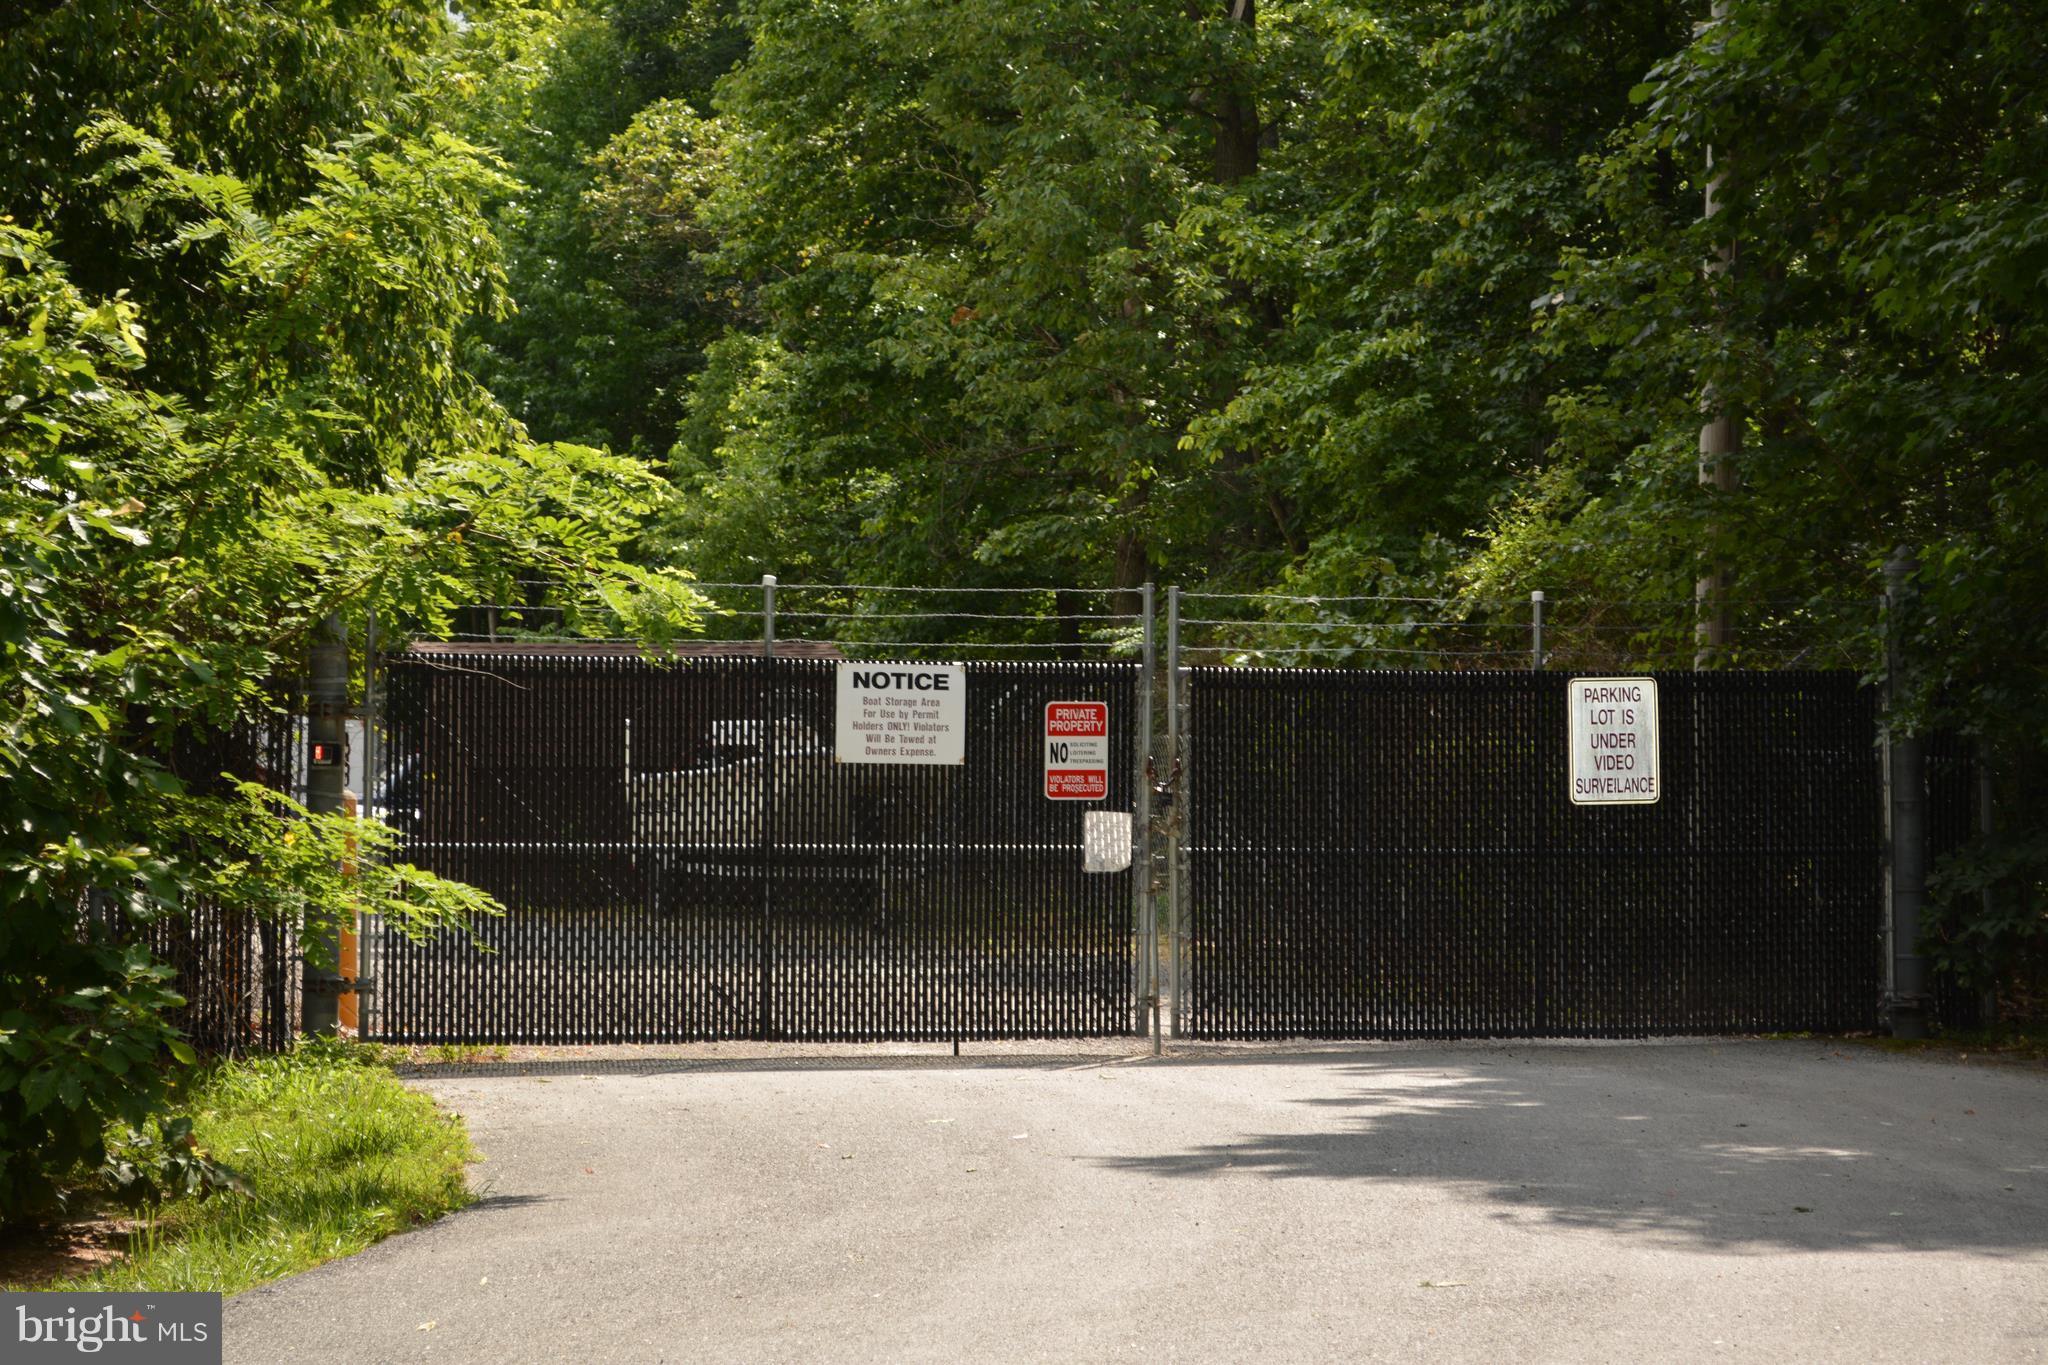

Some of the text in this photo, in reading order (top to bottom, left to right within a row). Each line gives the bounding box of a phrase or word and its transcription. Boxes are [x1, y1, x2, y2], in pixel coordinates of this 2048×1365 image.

[853, 671, 950, 691] NOTICE
[1584, 687, 1640, 703] PARKING
[863, 696, 940, 708] Boat Storage Area
[863, 709, 939, 720] For Use by Permit
[1056, 709, 1097, 719] PRIVATE
[1591, 709, 1634, 725] LOT IS
[852, 721, 949, 732] Holders ONLY! Violators
[1050, 721, 1103, 731] PROPERTY
[866, 734, 936, 744] Will Be Towed at
[1591, 733, 1636, 749] UNDER
[865, 746, 936, 757] Owners Expense.
[1050, 743, 1068, 763] NO
[1594, 754, 1634, 770] VIDEO
[1049, 775, 1103, 783] VIOLATORS WILL
[1049, 784, 1104, 792] BE PROSECUTED
[1576, 777, 1655, 794] SURVEILANCE
